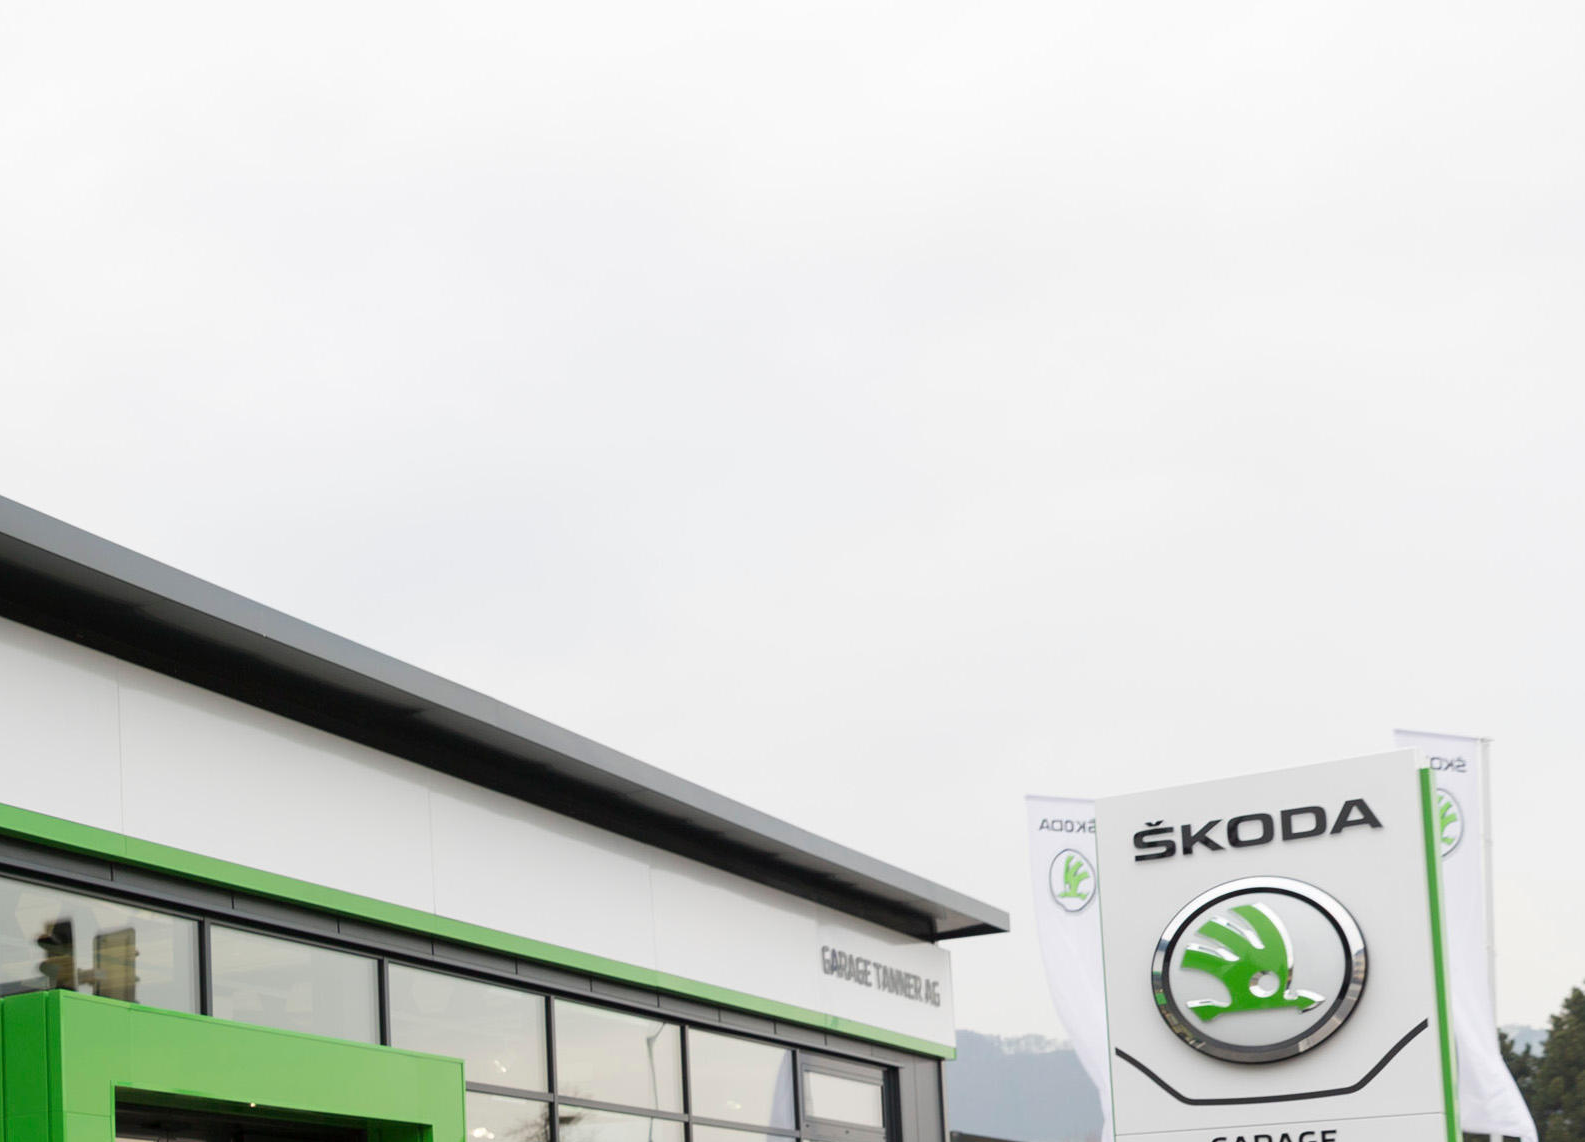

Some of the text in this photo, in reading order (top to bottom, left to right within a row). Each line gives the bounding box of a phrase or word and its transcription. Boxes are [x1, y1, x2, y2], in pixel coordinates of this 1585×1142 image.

[1132, 797, 1383, 862] ŠKODA
[821, 945, 941, 1007] GARAGE TANNER AG
